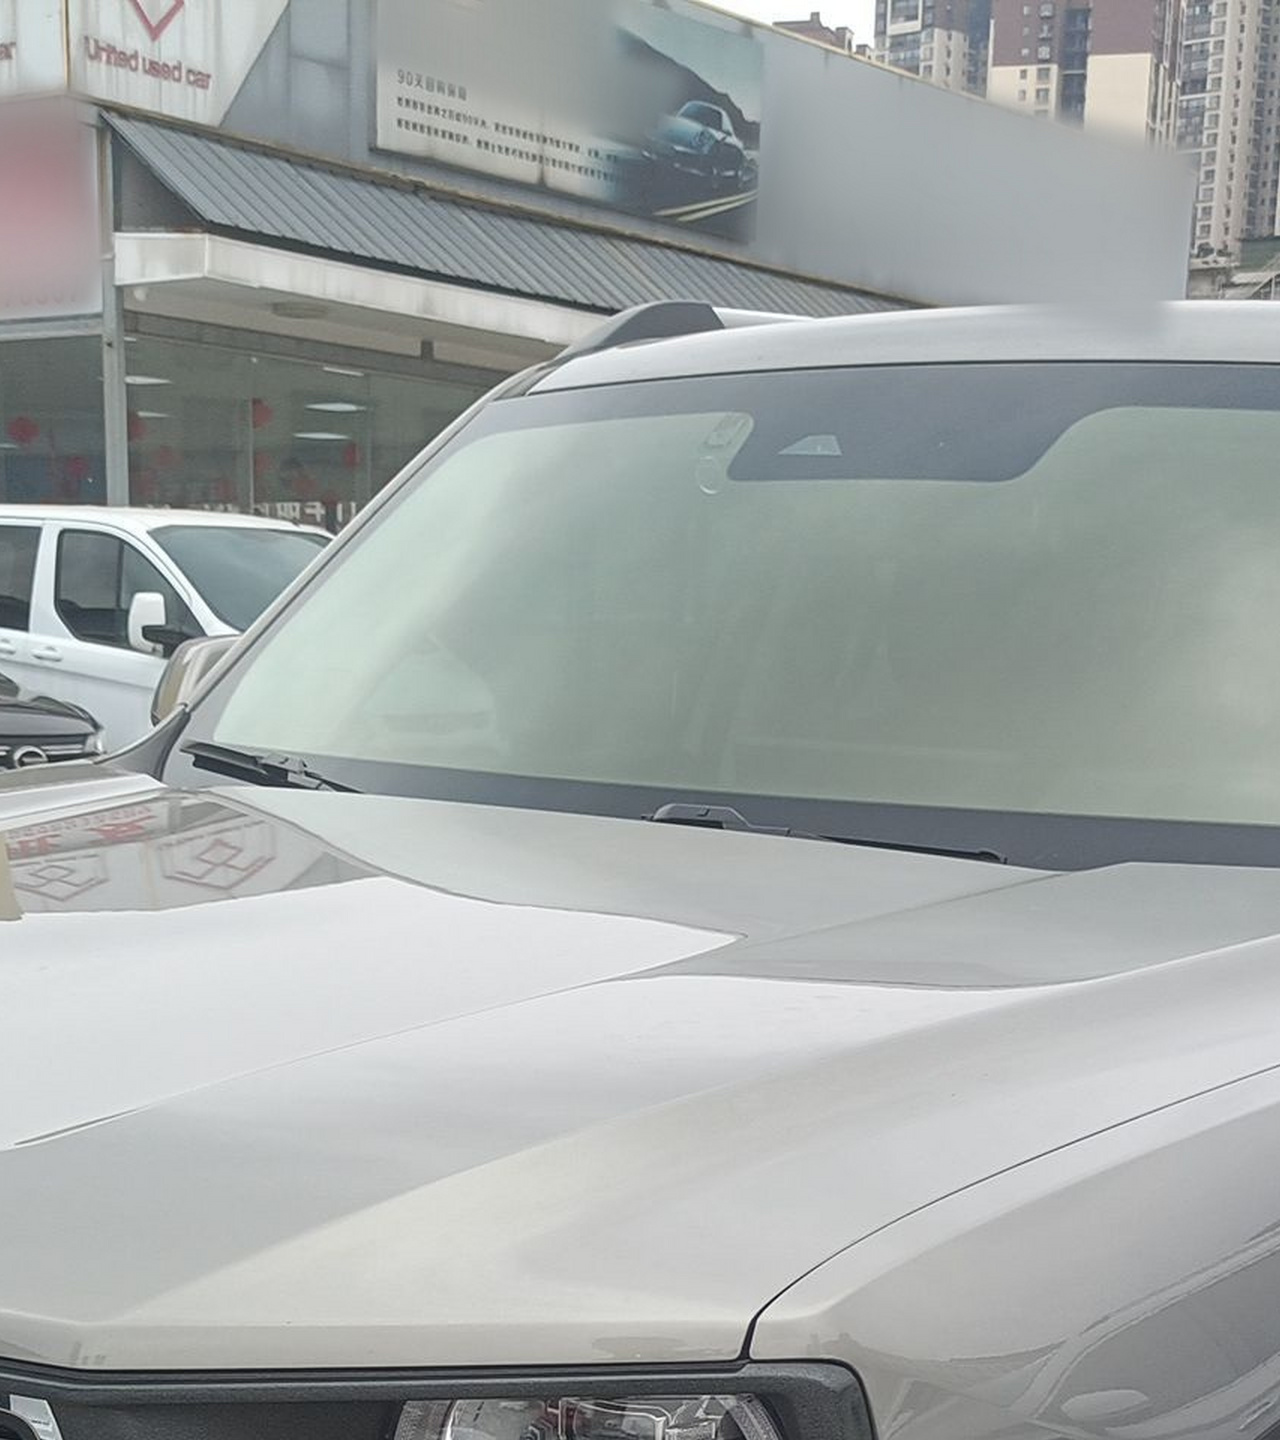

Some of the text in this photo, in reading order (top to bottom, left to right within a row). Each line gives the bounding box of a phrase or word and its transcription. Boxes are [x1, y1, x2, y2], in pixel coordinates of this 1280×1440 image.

[83, 36, 213, 90] United used car
